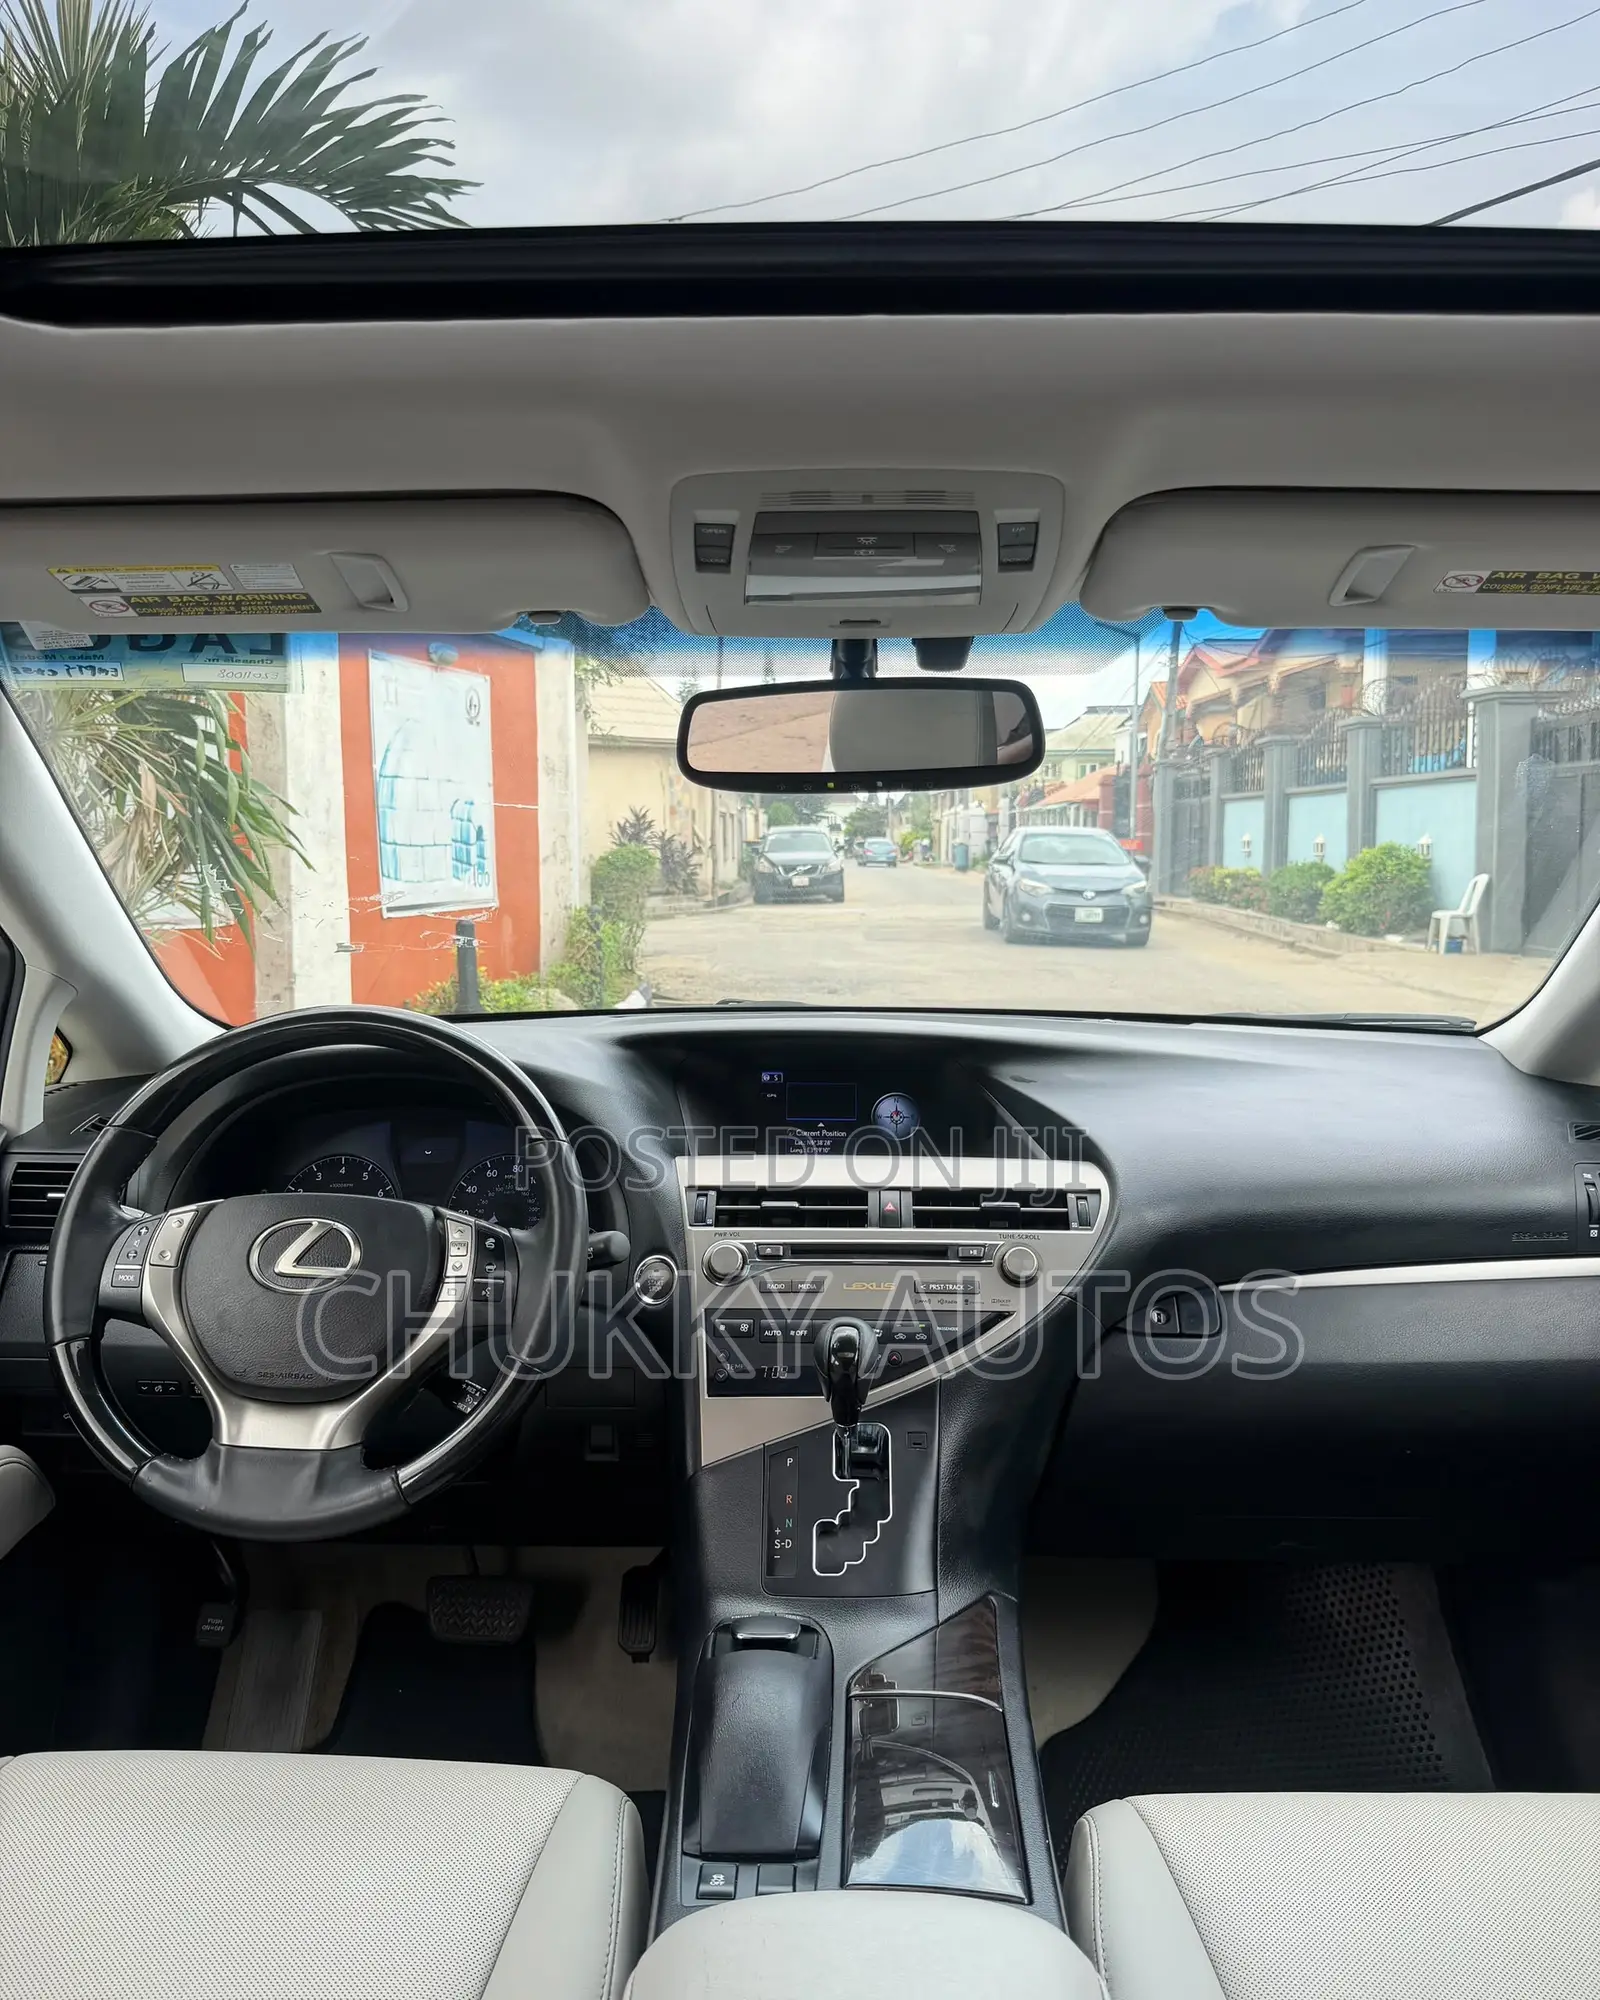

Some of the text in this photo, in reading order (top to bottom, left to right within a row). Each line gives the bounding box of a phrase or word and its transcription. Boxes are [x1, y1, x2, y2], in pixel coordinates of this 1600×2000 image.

[1535, 572, 1581, 580] BAG
[167, 595, 212, 603] BAG
[215, 593, 308, 602] WARNING
[821, 1129, 847, 1137] Position
[339, 1166, 346, 1175] 4
[486, 1169, 498, 1177] 60
[512, 1164, 524, 1173] 80
[316, 1172, 323, 1181] 3
[362, 1172, 369, 1181] 5
[377, 1189, 384, 1198] 6
[465, 1185, 477, 1194] 40
[766, 1282, 785, 1290] RADIO
[797, 1282, 817, 1290] MEDIA
[842, 1281, 896, 1291] LEXUS
[795, 1329, 809, 1337] OFF
[786, 1457, 794, 1467] P
[785, 1494, 793, 1504] R
[785, 1518, 793, 1528] N
